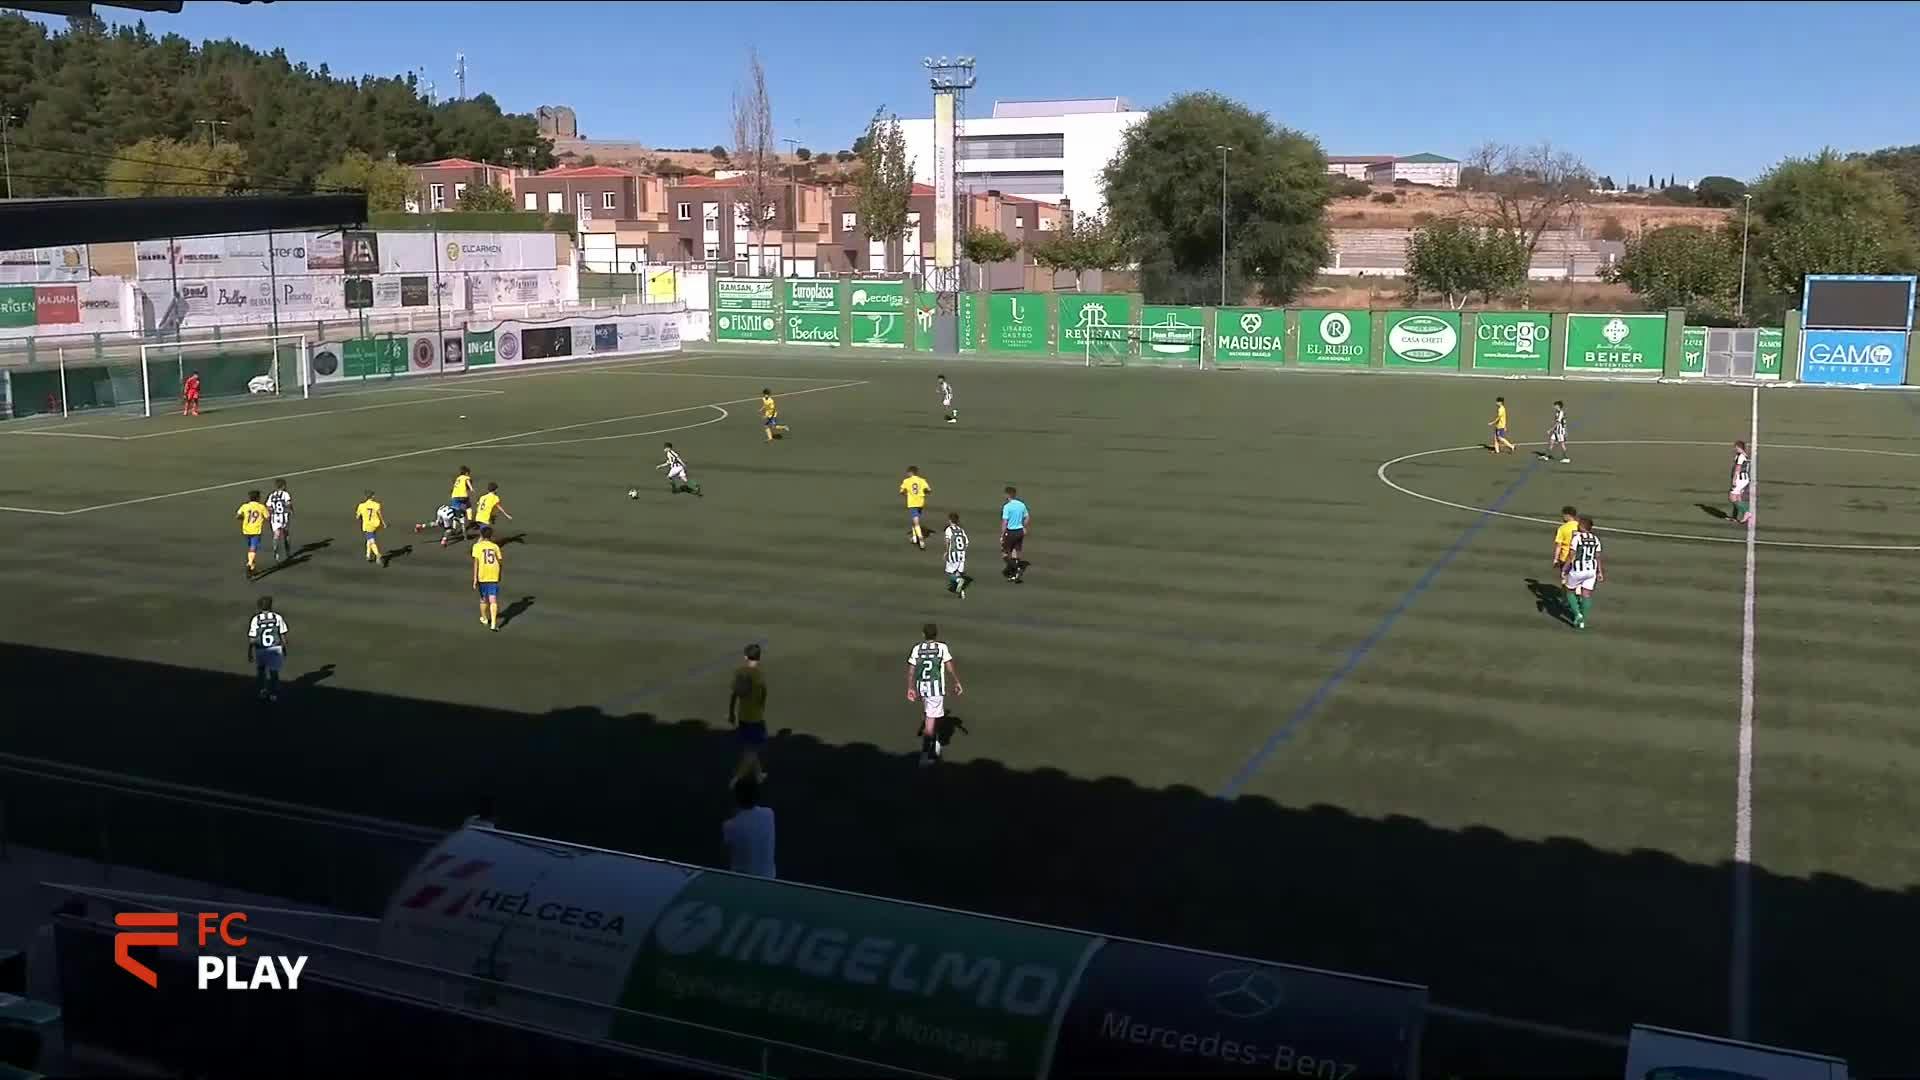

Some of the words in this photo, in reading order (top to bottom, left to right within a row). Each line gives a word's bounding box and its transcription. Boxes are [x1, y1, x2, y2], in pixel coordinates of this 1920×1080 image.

[793, 283, 834, 302] Europlassa
[1065, 329, 1121, 339] REVISAN
[1478, 322, 1550, 347] crego
[1219, 336, 1281, 350] MAGUISA
[1307, 344, 1321, 354] EL
[1325, 345, 1364, 356] RUBIO
[1585, 352, 1643, 363] BEHER
[1809, 344, 1893, 365] GAMO
[248, 510, 259, 524] 19
[367, 507, 373, 521] 7
[956, 536, 965, 551] 8
[483, 548, 495, 564] 15
[262, 628, 274, 647] 6
[922, 660, 932, 679] 2
[475, 888, 625, 936] HELCESA
[716, 914, 1058, 1016] INGELMO
[1100, 1012, 1360, 1079] Mercedes-Benz
